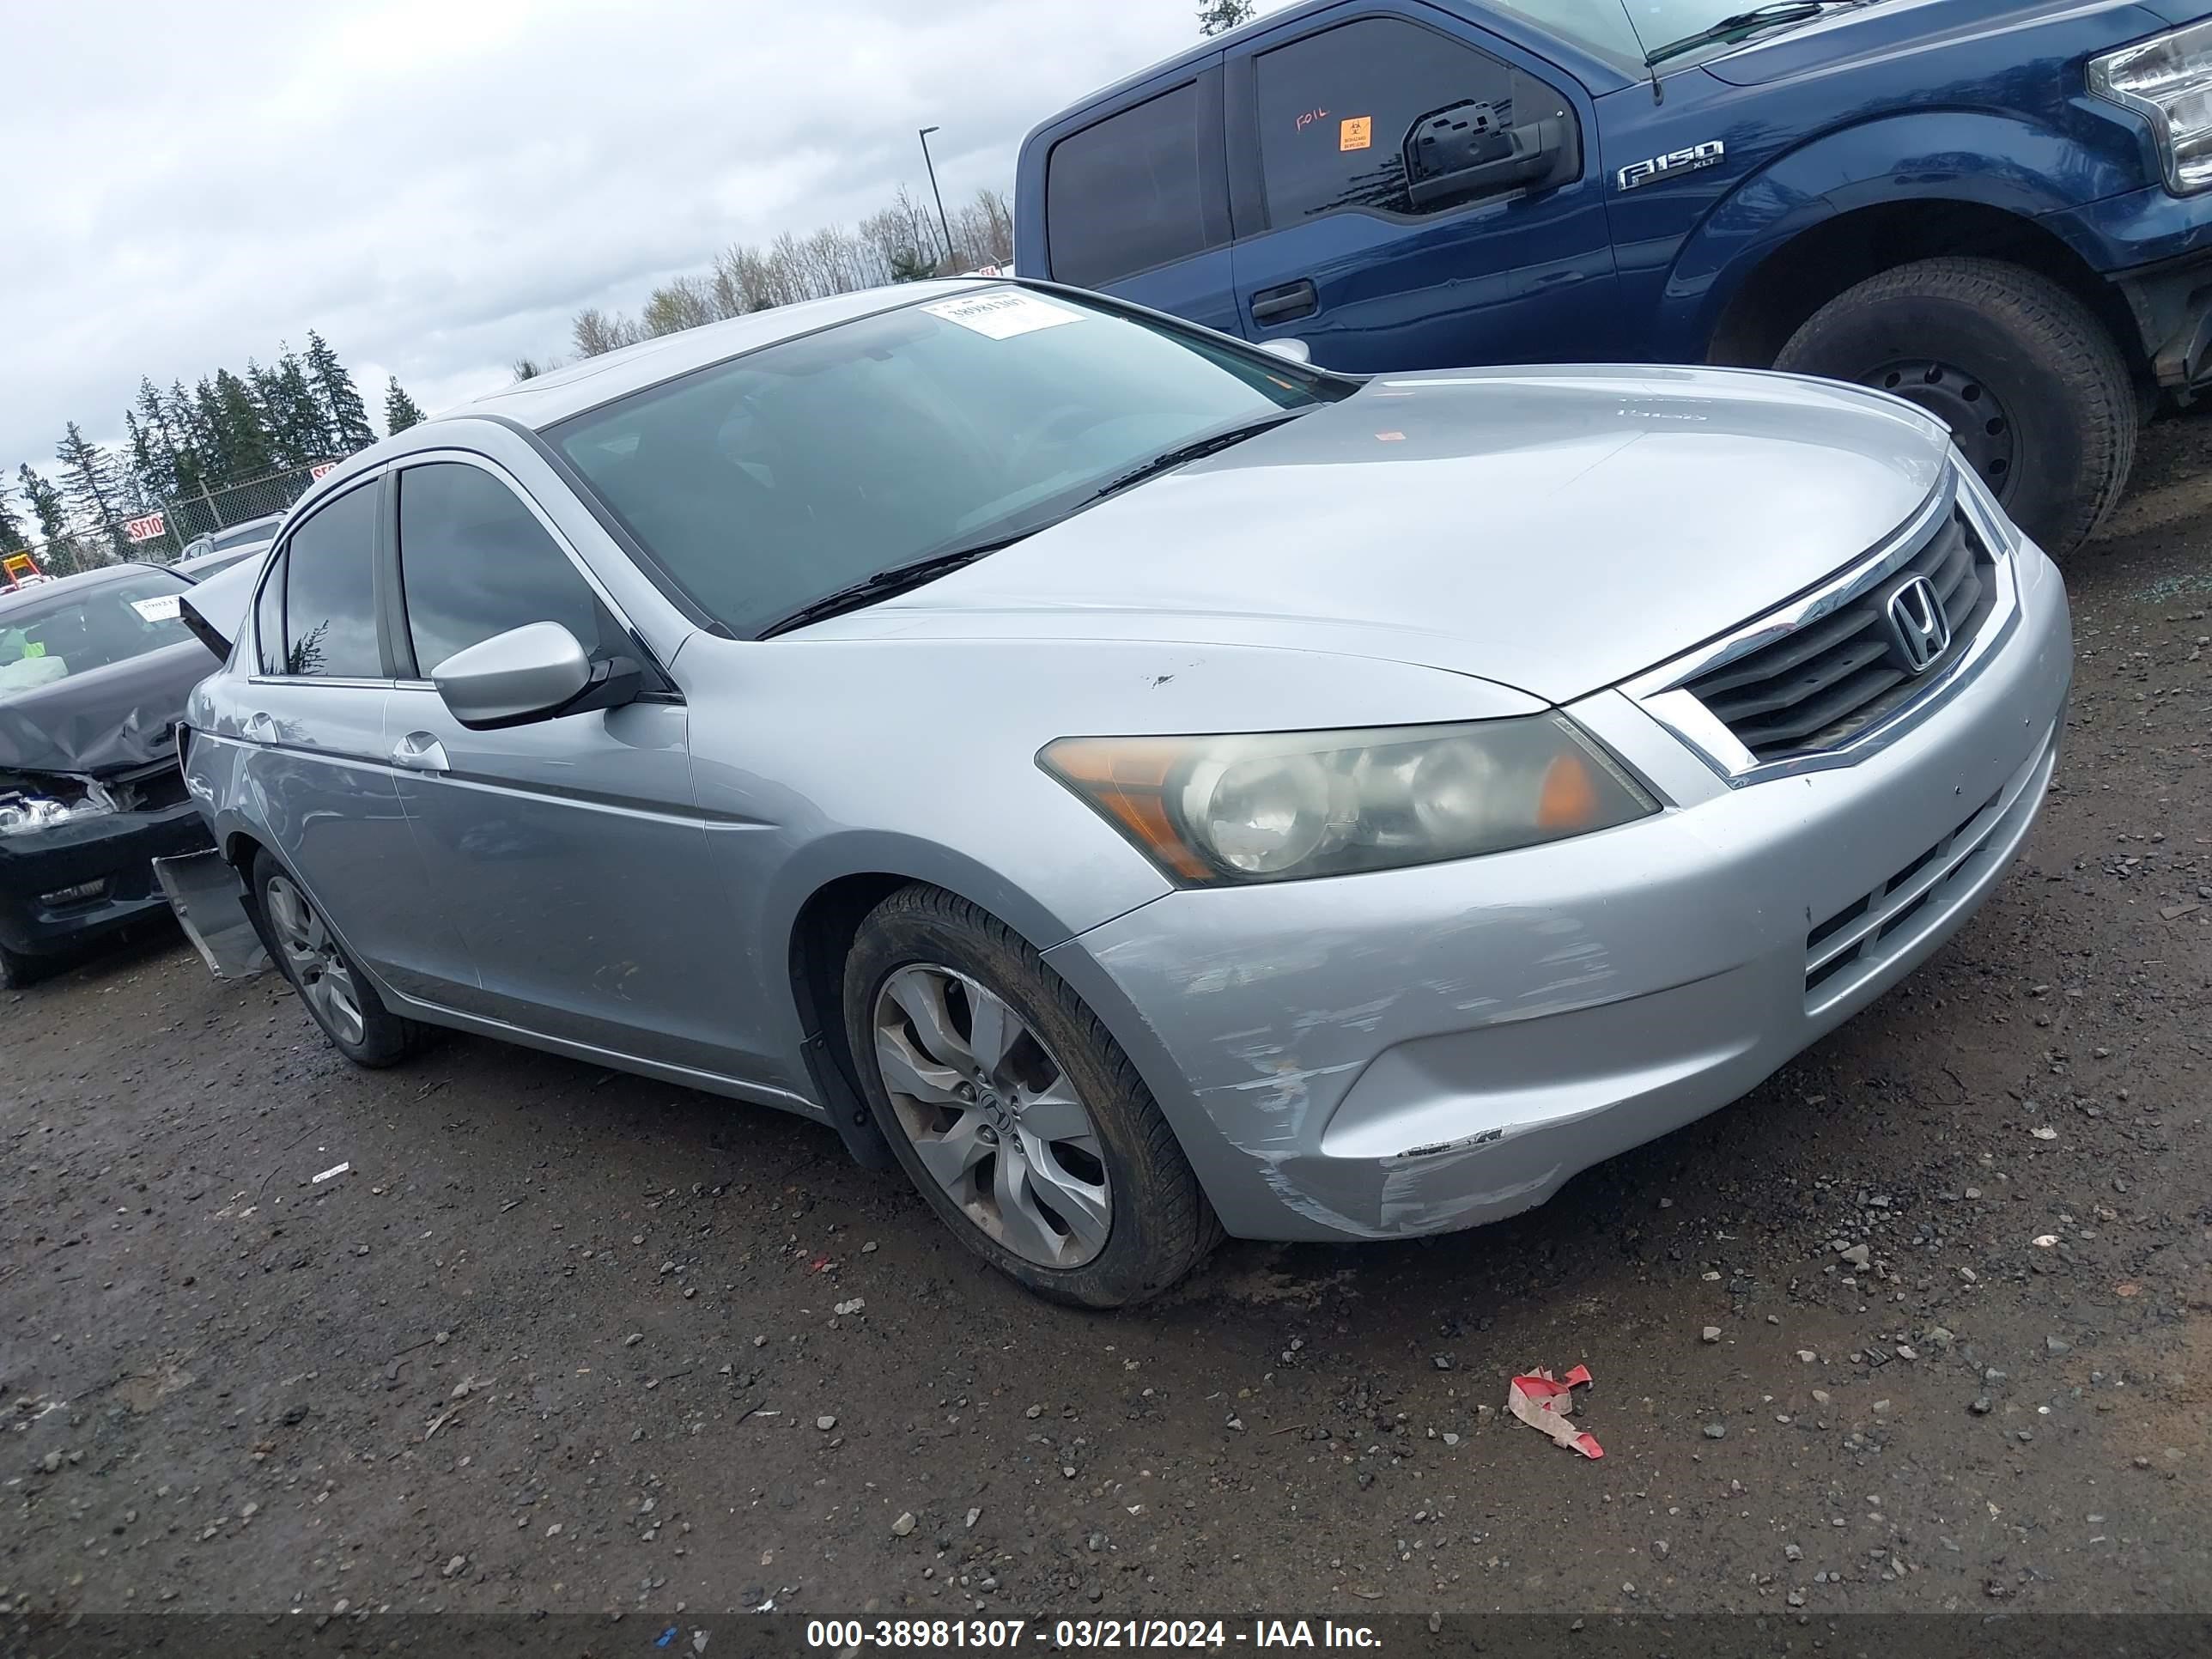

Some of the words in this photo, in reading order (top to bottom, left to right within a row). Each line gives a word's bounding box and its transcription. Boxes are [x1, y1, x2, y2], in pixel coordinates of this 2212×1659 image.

[1693, 157, 1716, 170] XLT
[947, 298, 1027, 317] 38981307
[131, 517, 162, 538] SF10
